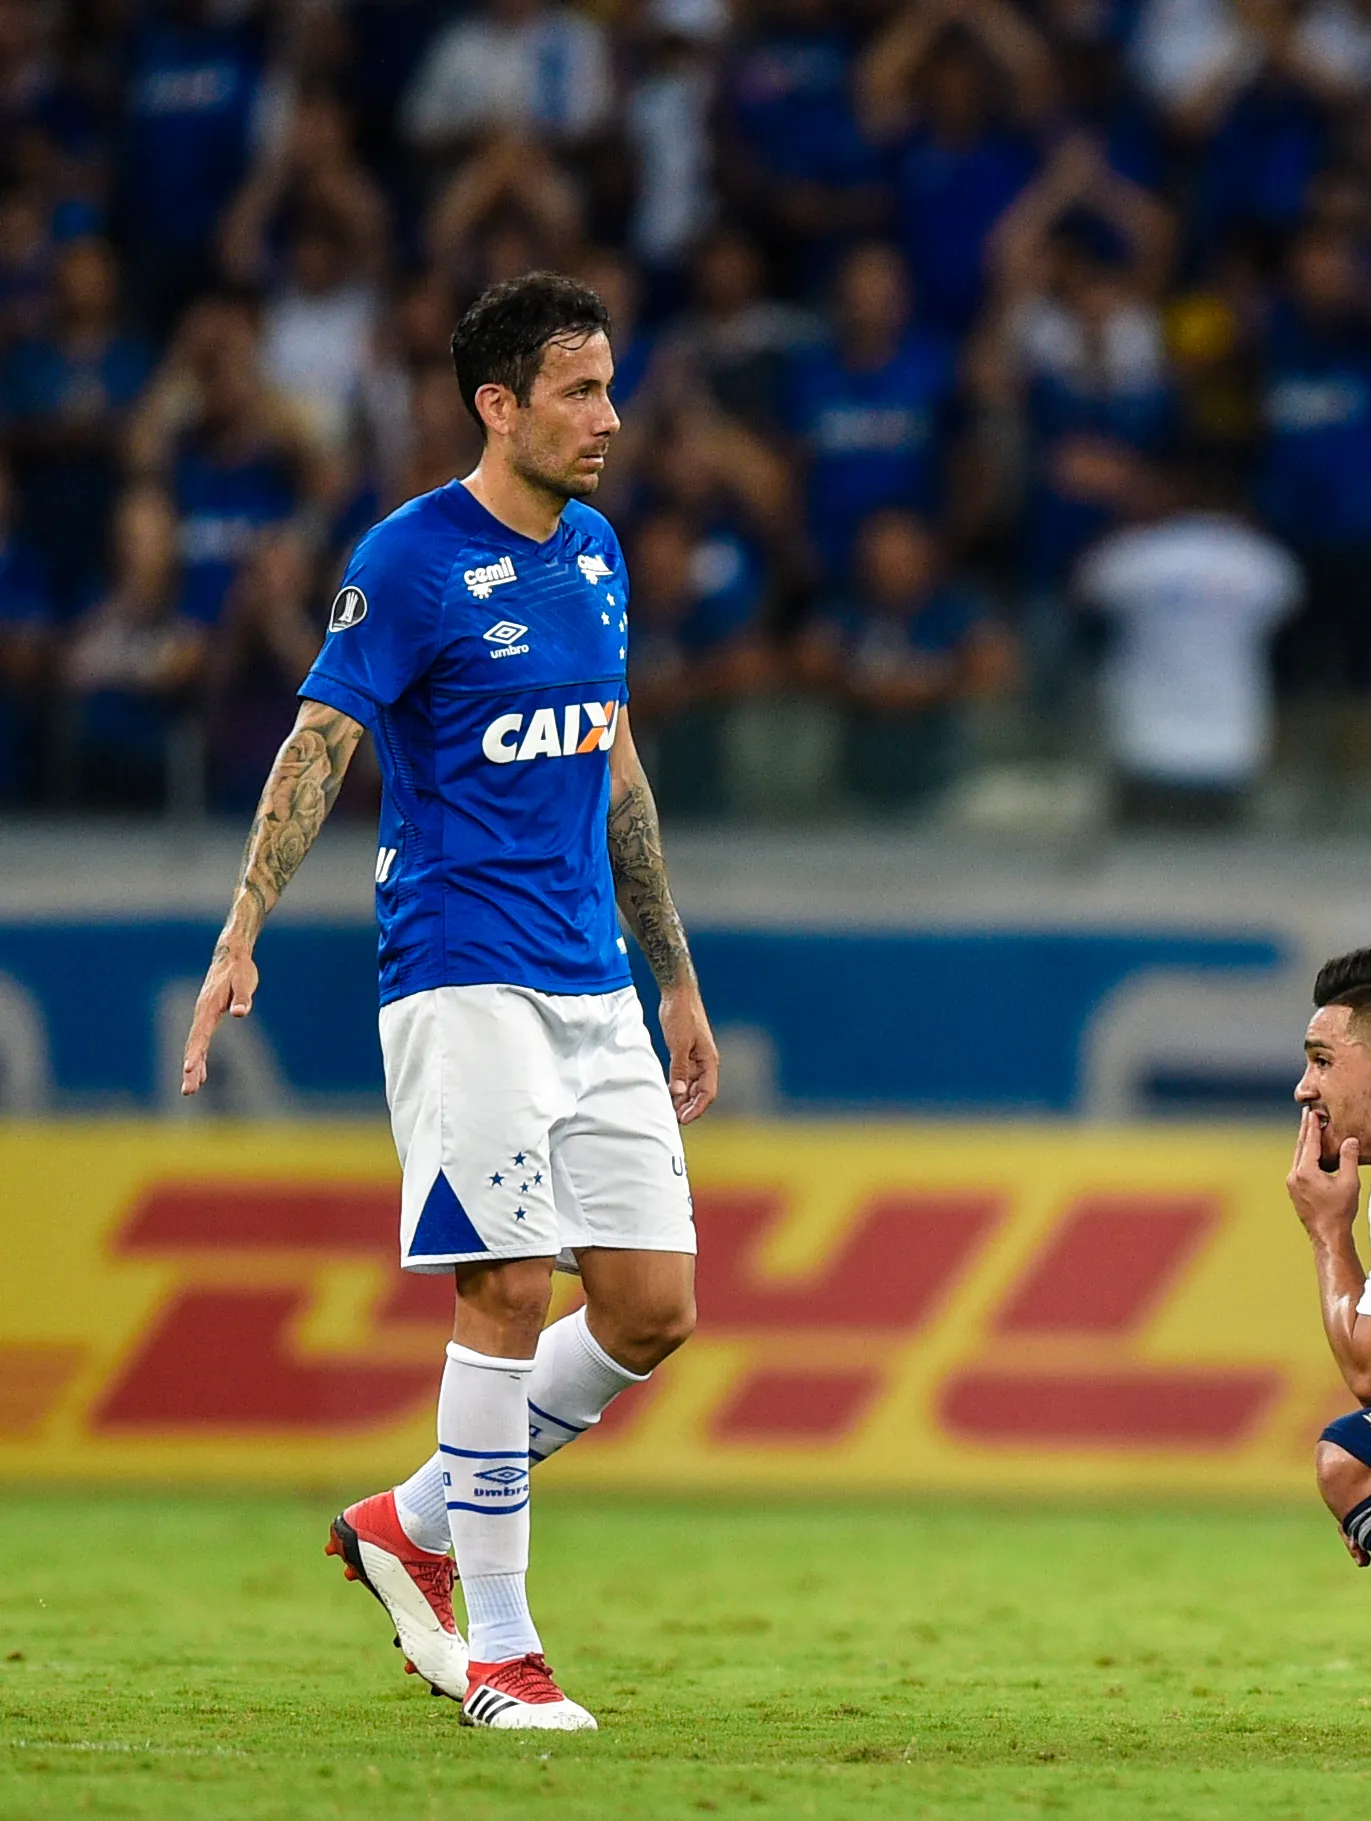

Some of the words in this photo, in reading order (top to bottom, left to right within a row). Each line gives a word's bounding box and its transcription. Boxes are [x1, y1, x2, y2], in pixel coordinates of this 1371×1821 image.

[463, 556, 515, 586] cemil
[490, 644, 530, 659] umbro
[482, 700, 620, 764] CAIX
[90, 1180, 1290, 1446] DHL
